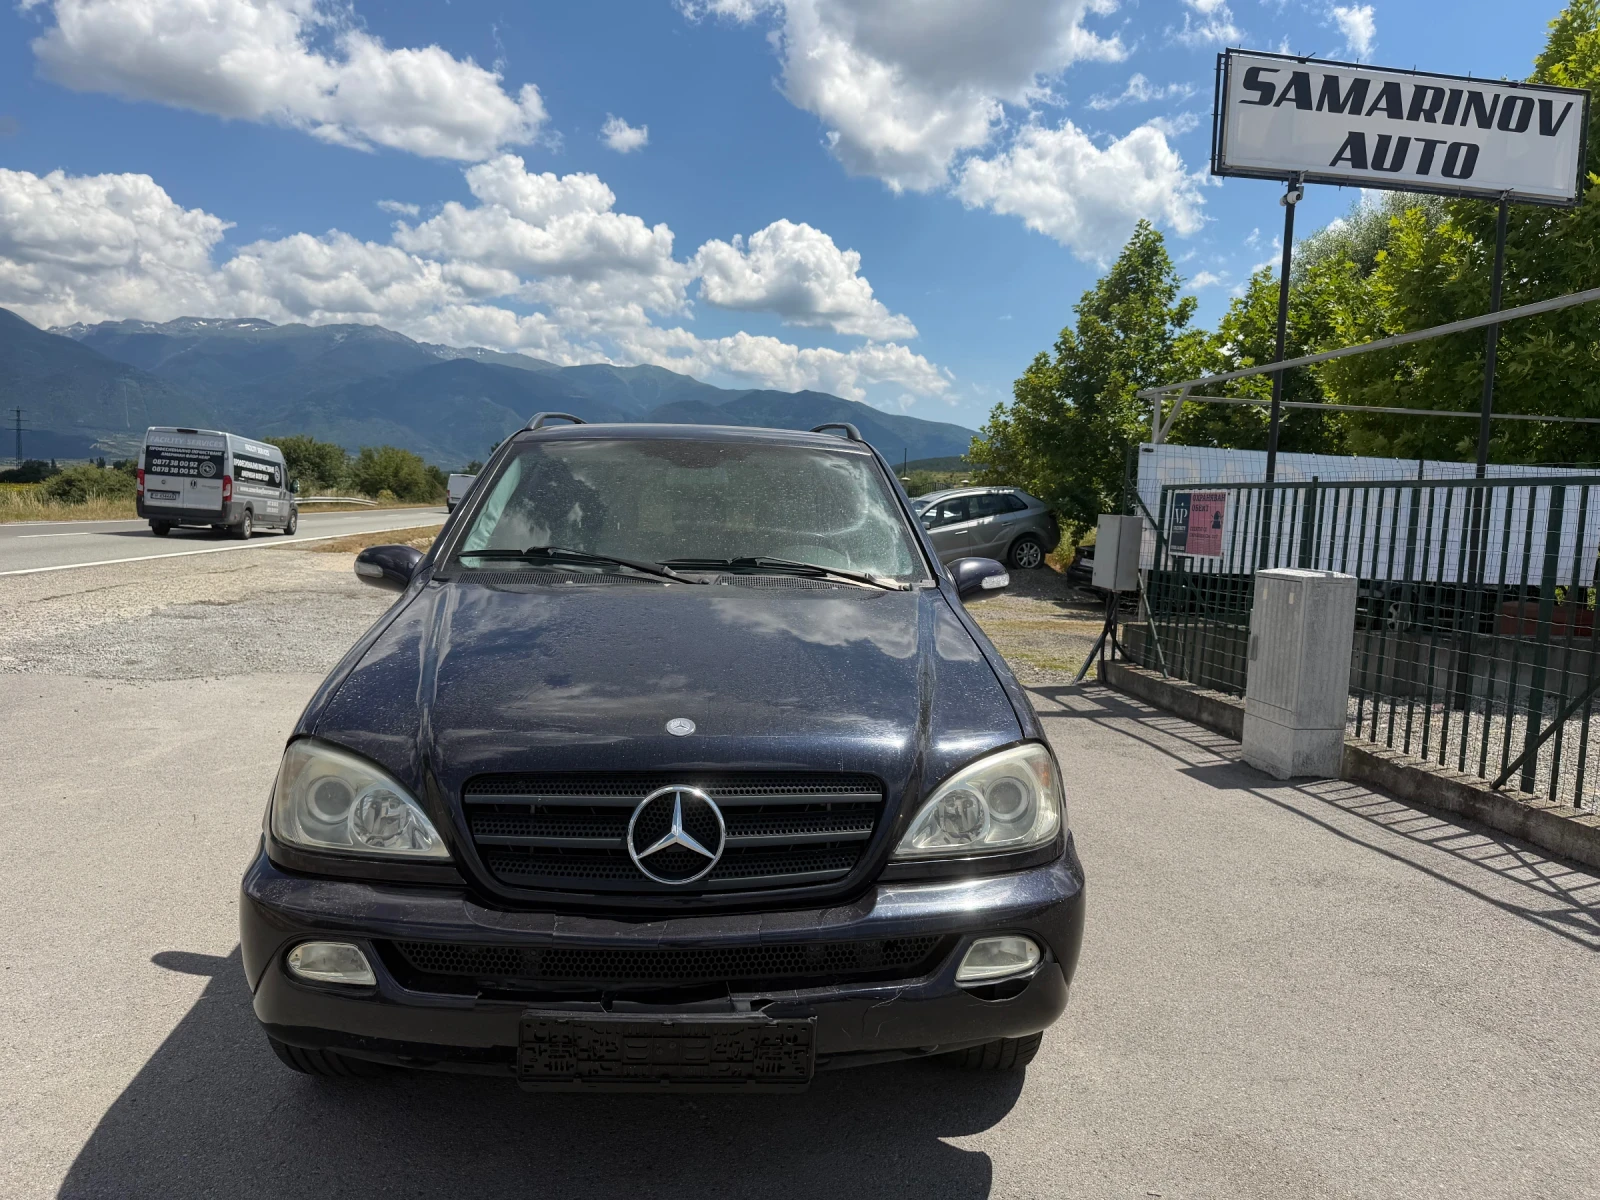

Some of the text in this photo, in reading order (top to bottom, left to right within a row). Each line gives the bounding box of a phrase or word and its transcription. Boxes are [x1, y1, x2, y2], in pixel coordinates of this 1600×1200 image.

[1238, 66, 1574, 137] SAMARINOV
[1329, 131, 1480, 179] AUTO
[150, 436, 224, 448] FACILITY SERVICES
[1192, 493, 1226, 502] ОХРАНЯВАН
[1191, 504, 1209, 512] ОБЕКТ
